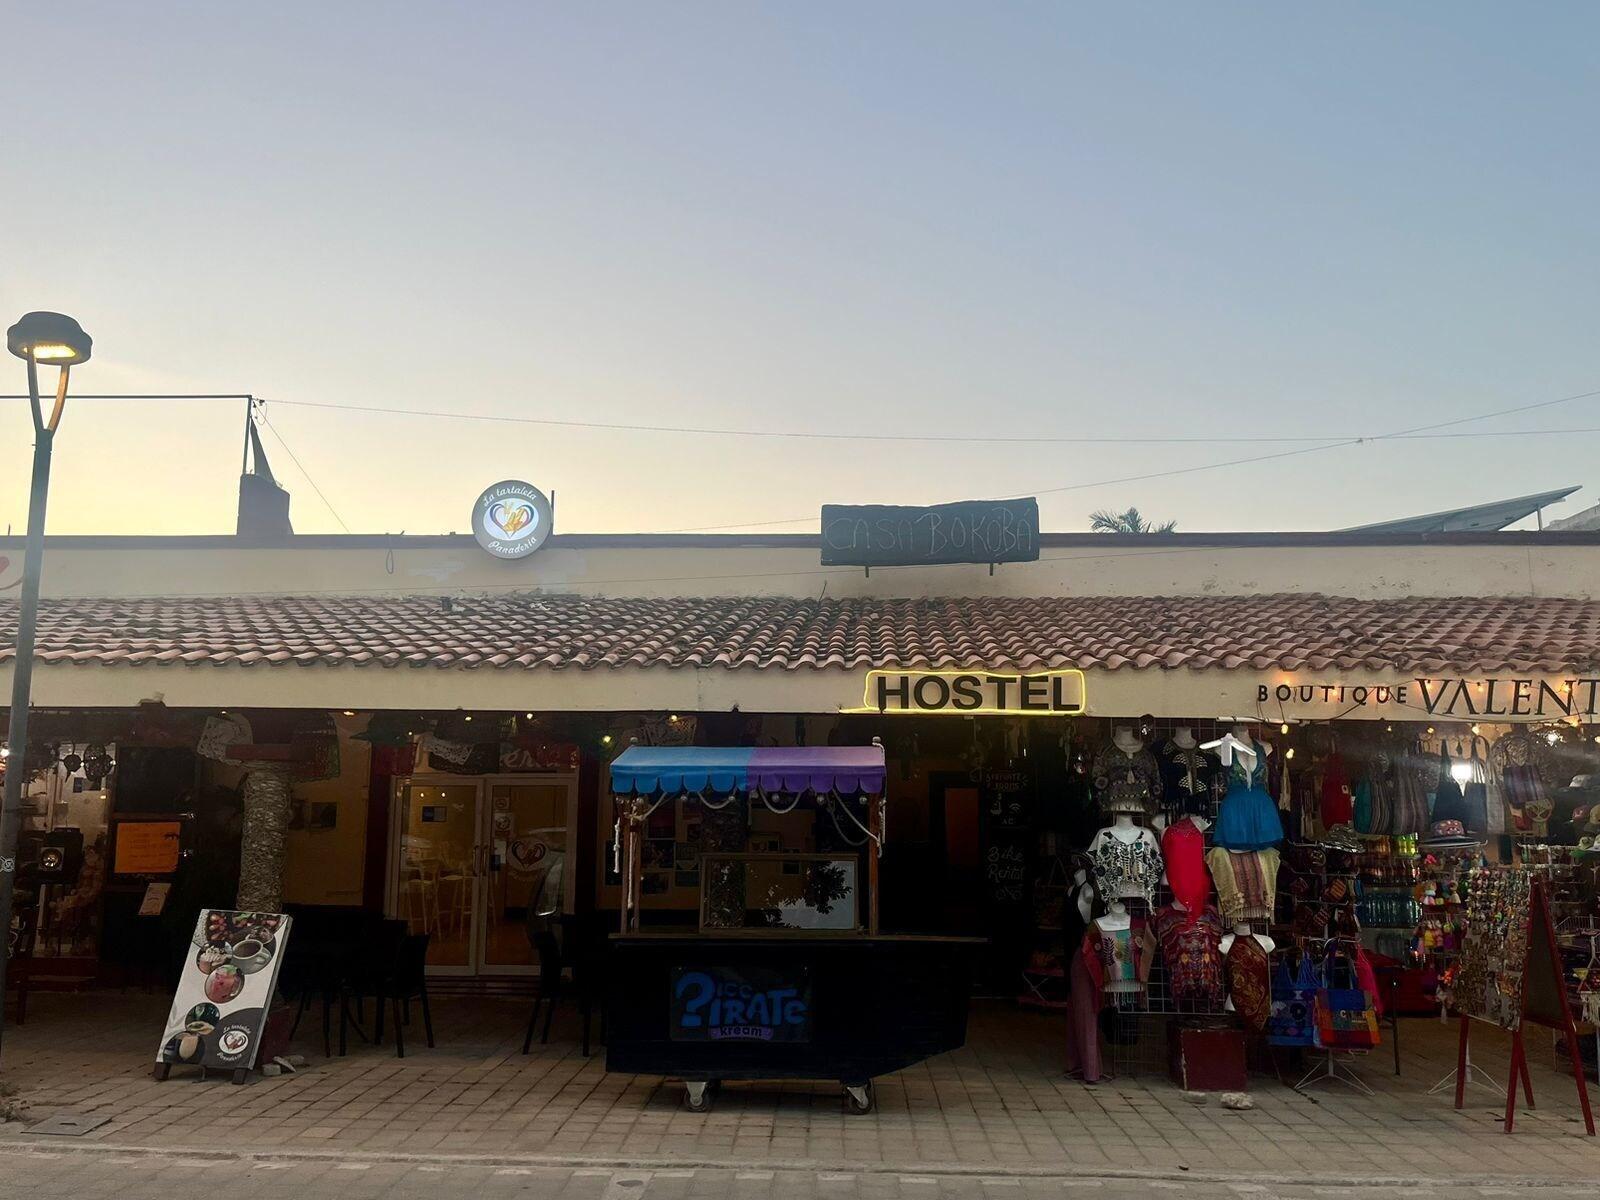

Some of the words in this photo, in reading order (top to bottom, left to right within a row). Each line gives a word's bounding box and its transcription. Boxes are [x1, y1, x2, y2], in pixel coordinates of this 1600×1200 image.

[483, 494, 495, 507] La
[496, 485, 537, 501] tartaleta
[824, 517, 914, 551] CASA
[877, 675, 1080, 711] HOSTEL
[1257, 684, 1407, 705] BOUTIQUE
[720, 1026, 762, 1038] kream
